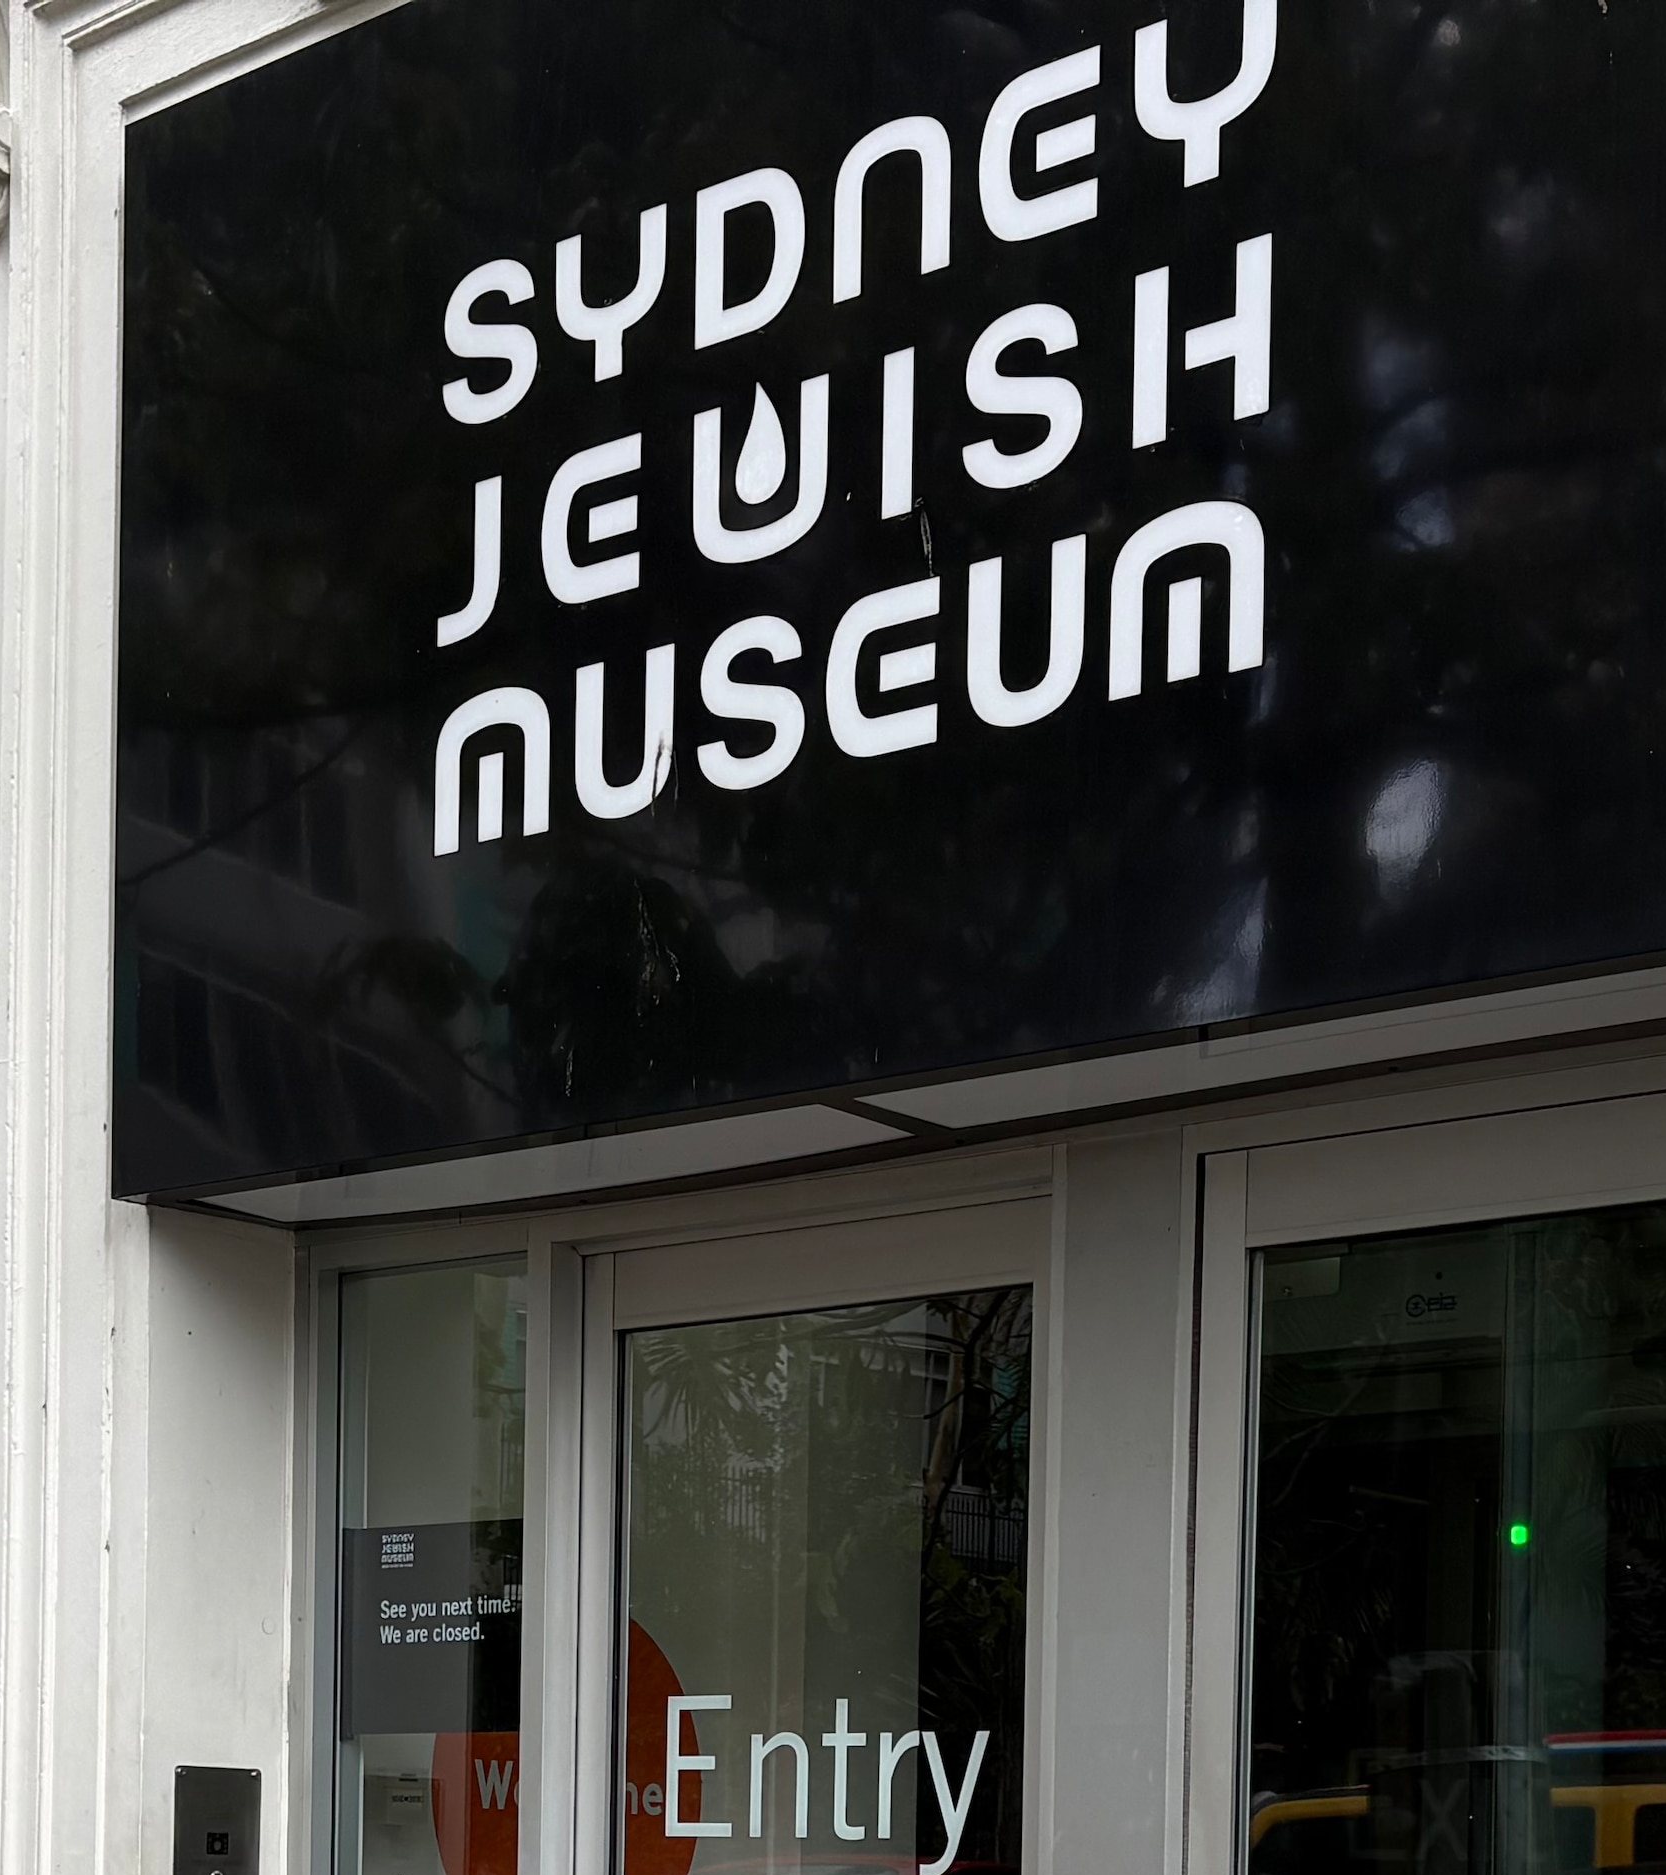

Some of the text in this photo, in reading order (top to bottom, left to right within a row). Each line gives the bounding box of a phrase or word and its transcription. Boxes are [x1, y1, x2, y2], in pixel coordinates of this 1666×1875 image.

[442, 0, 1277, 424] SYDNEY
[437, 233, 1272, 646] JEWISH
[434, 500, 1265, 856] MUSEUM
[380, 1600, 407, 1619] See
[411, 1602, 437, 1622] you
[441, 1597, 473, 1616] next
[380, 1621, 485, 1644] We are closed.
